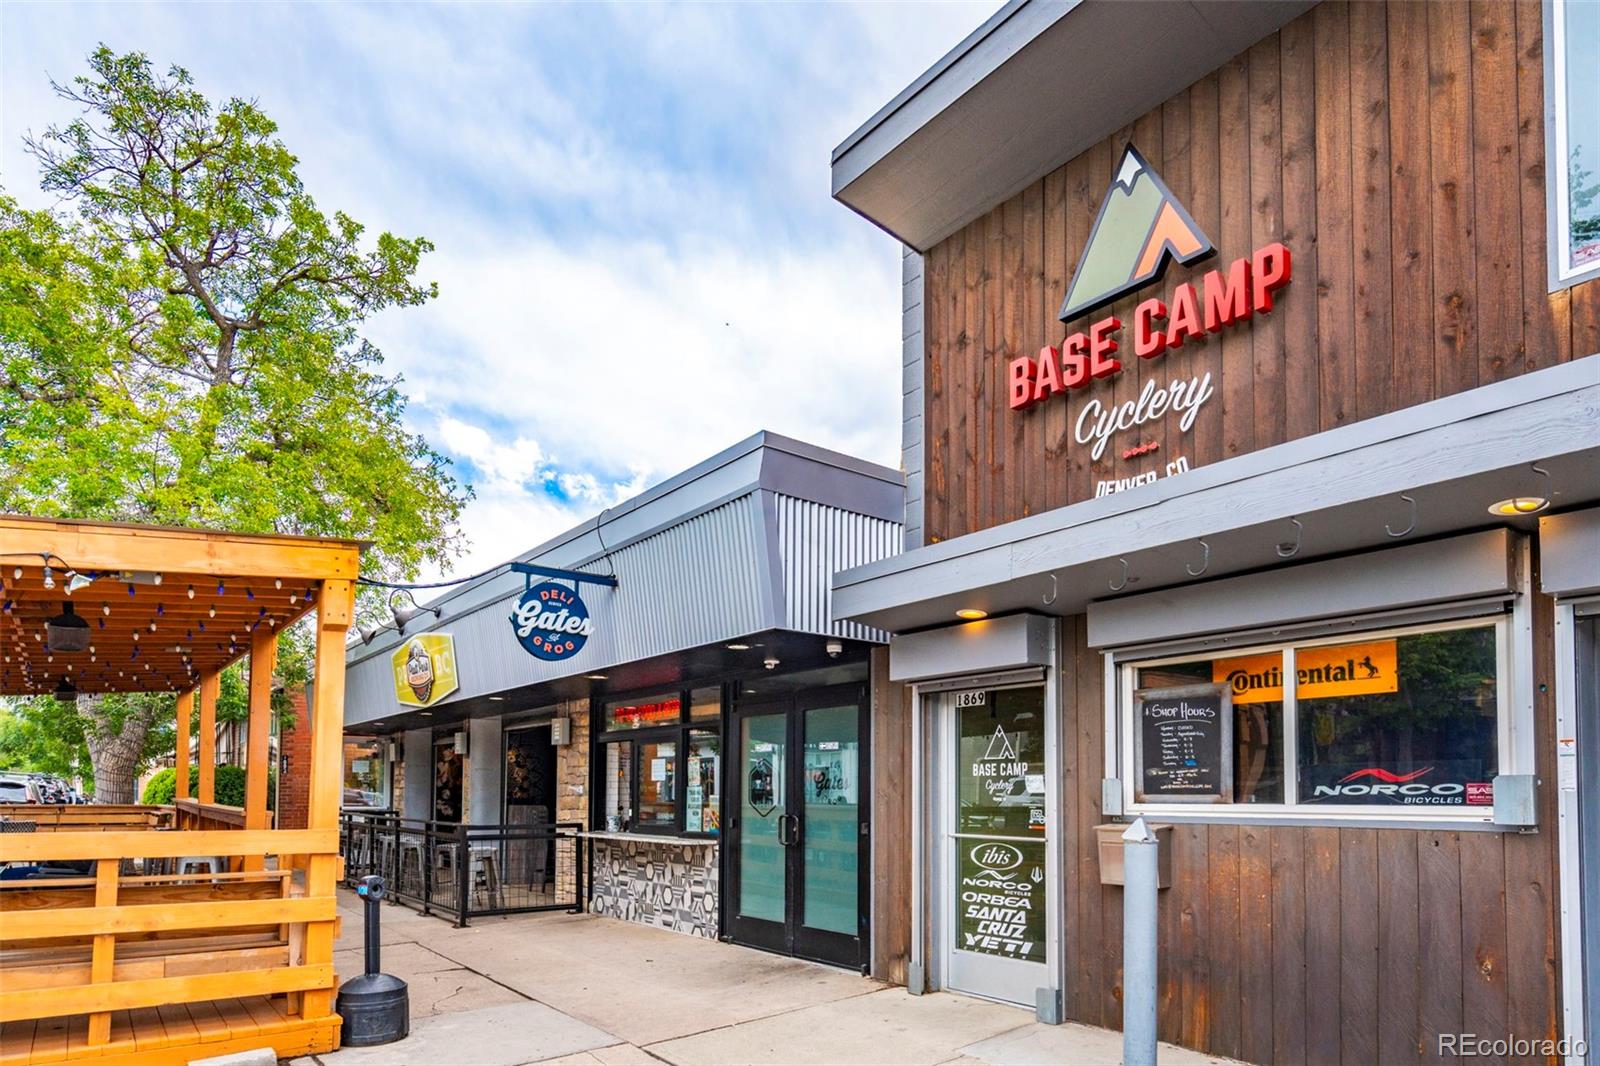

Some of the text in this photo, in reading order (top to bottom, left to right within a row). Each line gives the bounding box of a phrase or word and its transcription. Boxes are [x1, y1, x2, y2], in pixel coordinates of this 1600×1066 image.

[1010, 242, 1292, 411] BASE CAMP
[1074, 372, 1214, 461] Cyclery
[540, 589, 574, 605] DELI
[512, 599, 596, 637] Gates
[533, 636, 574, 654] GROG
[1226, 659, 1356, 696] Contiental
[958, 692, 984, 706] 1869
[1181, 702, 1216, 720] HOURS
[973, 762, 1028, 776] BASE CAMP
[985, 779, 1014, 795] Cyclery
[1313, 783, 1464, 796] NORCO
[1404, 796, 1462, 804] BICYCLES
[982, 846, 1011, 864] ibis
[963, 877, 1032, 891] NORCO
[962, 892, 1032, 909] ORBEA
[965, 905, 1026, 924] SANTA
[977, 920, 1027, 938] CRUZ
